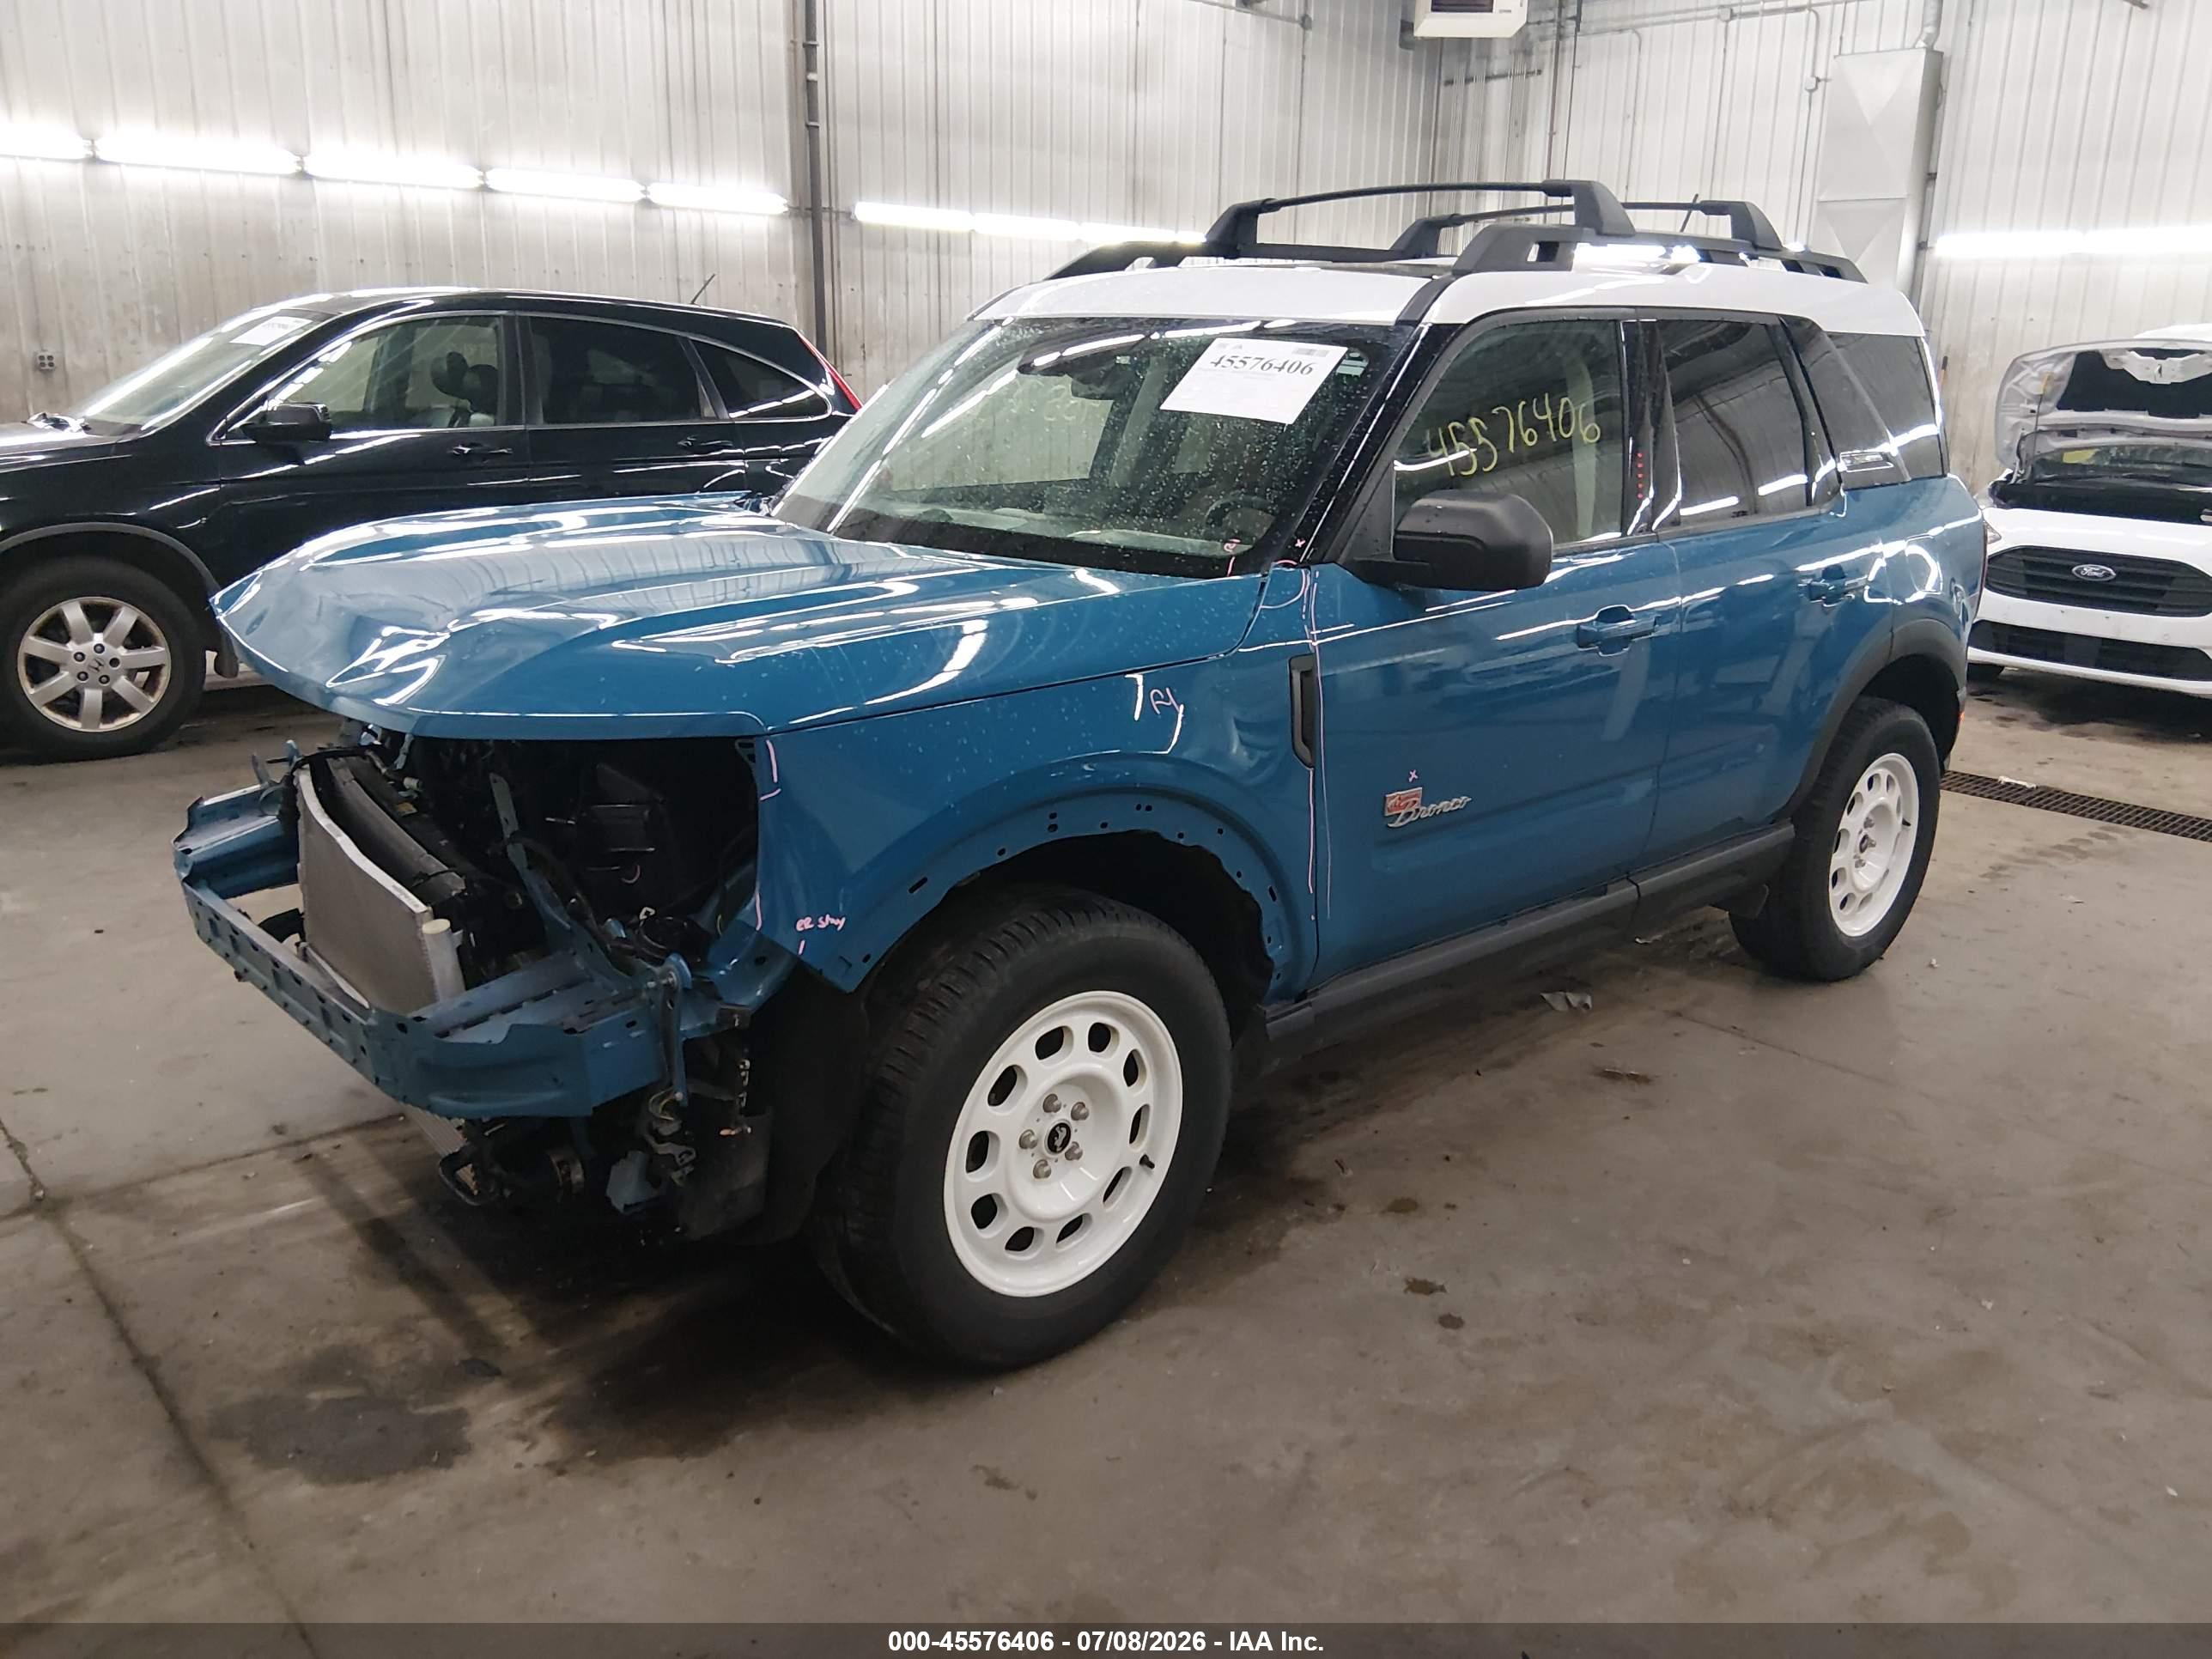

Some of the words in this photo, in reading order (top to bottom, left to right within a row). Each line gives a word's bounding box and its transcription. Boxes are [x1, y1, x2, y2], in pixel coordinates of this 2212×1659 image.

[1210, 354, 1317, 376] 45576406
[1425, 392, 1601, 477] 45576406
[1387, 795, 1473, 828] Bronco
